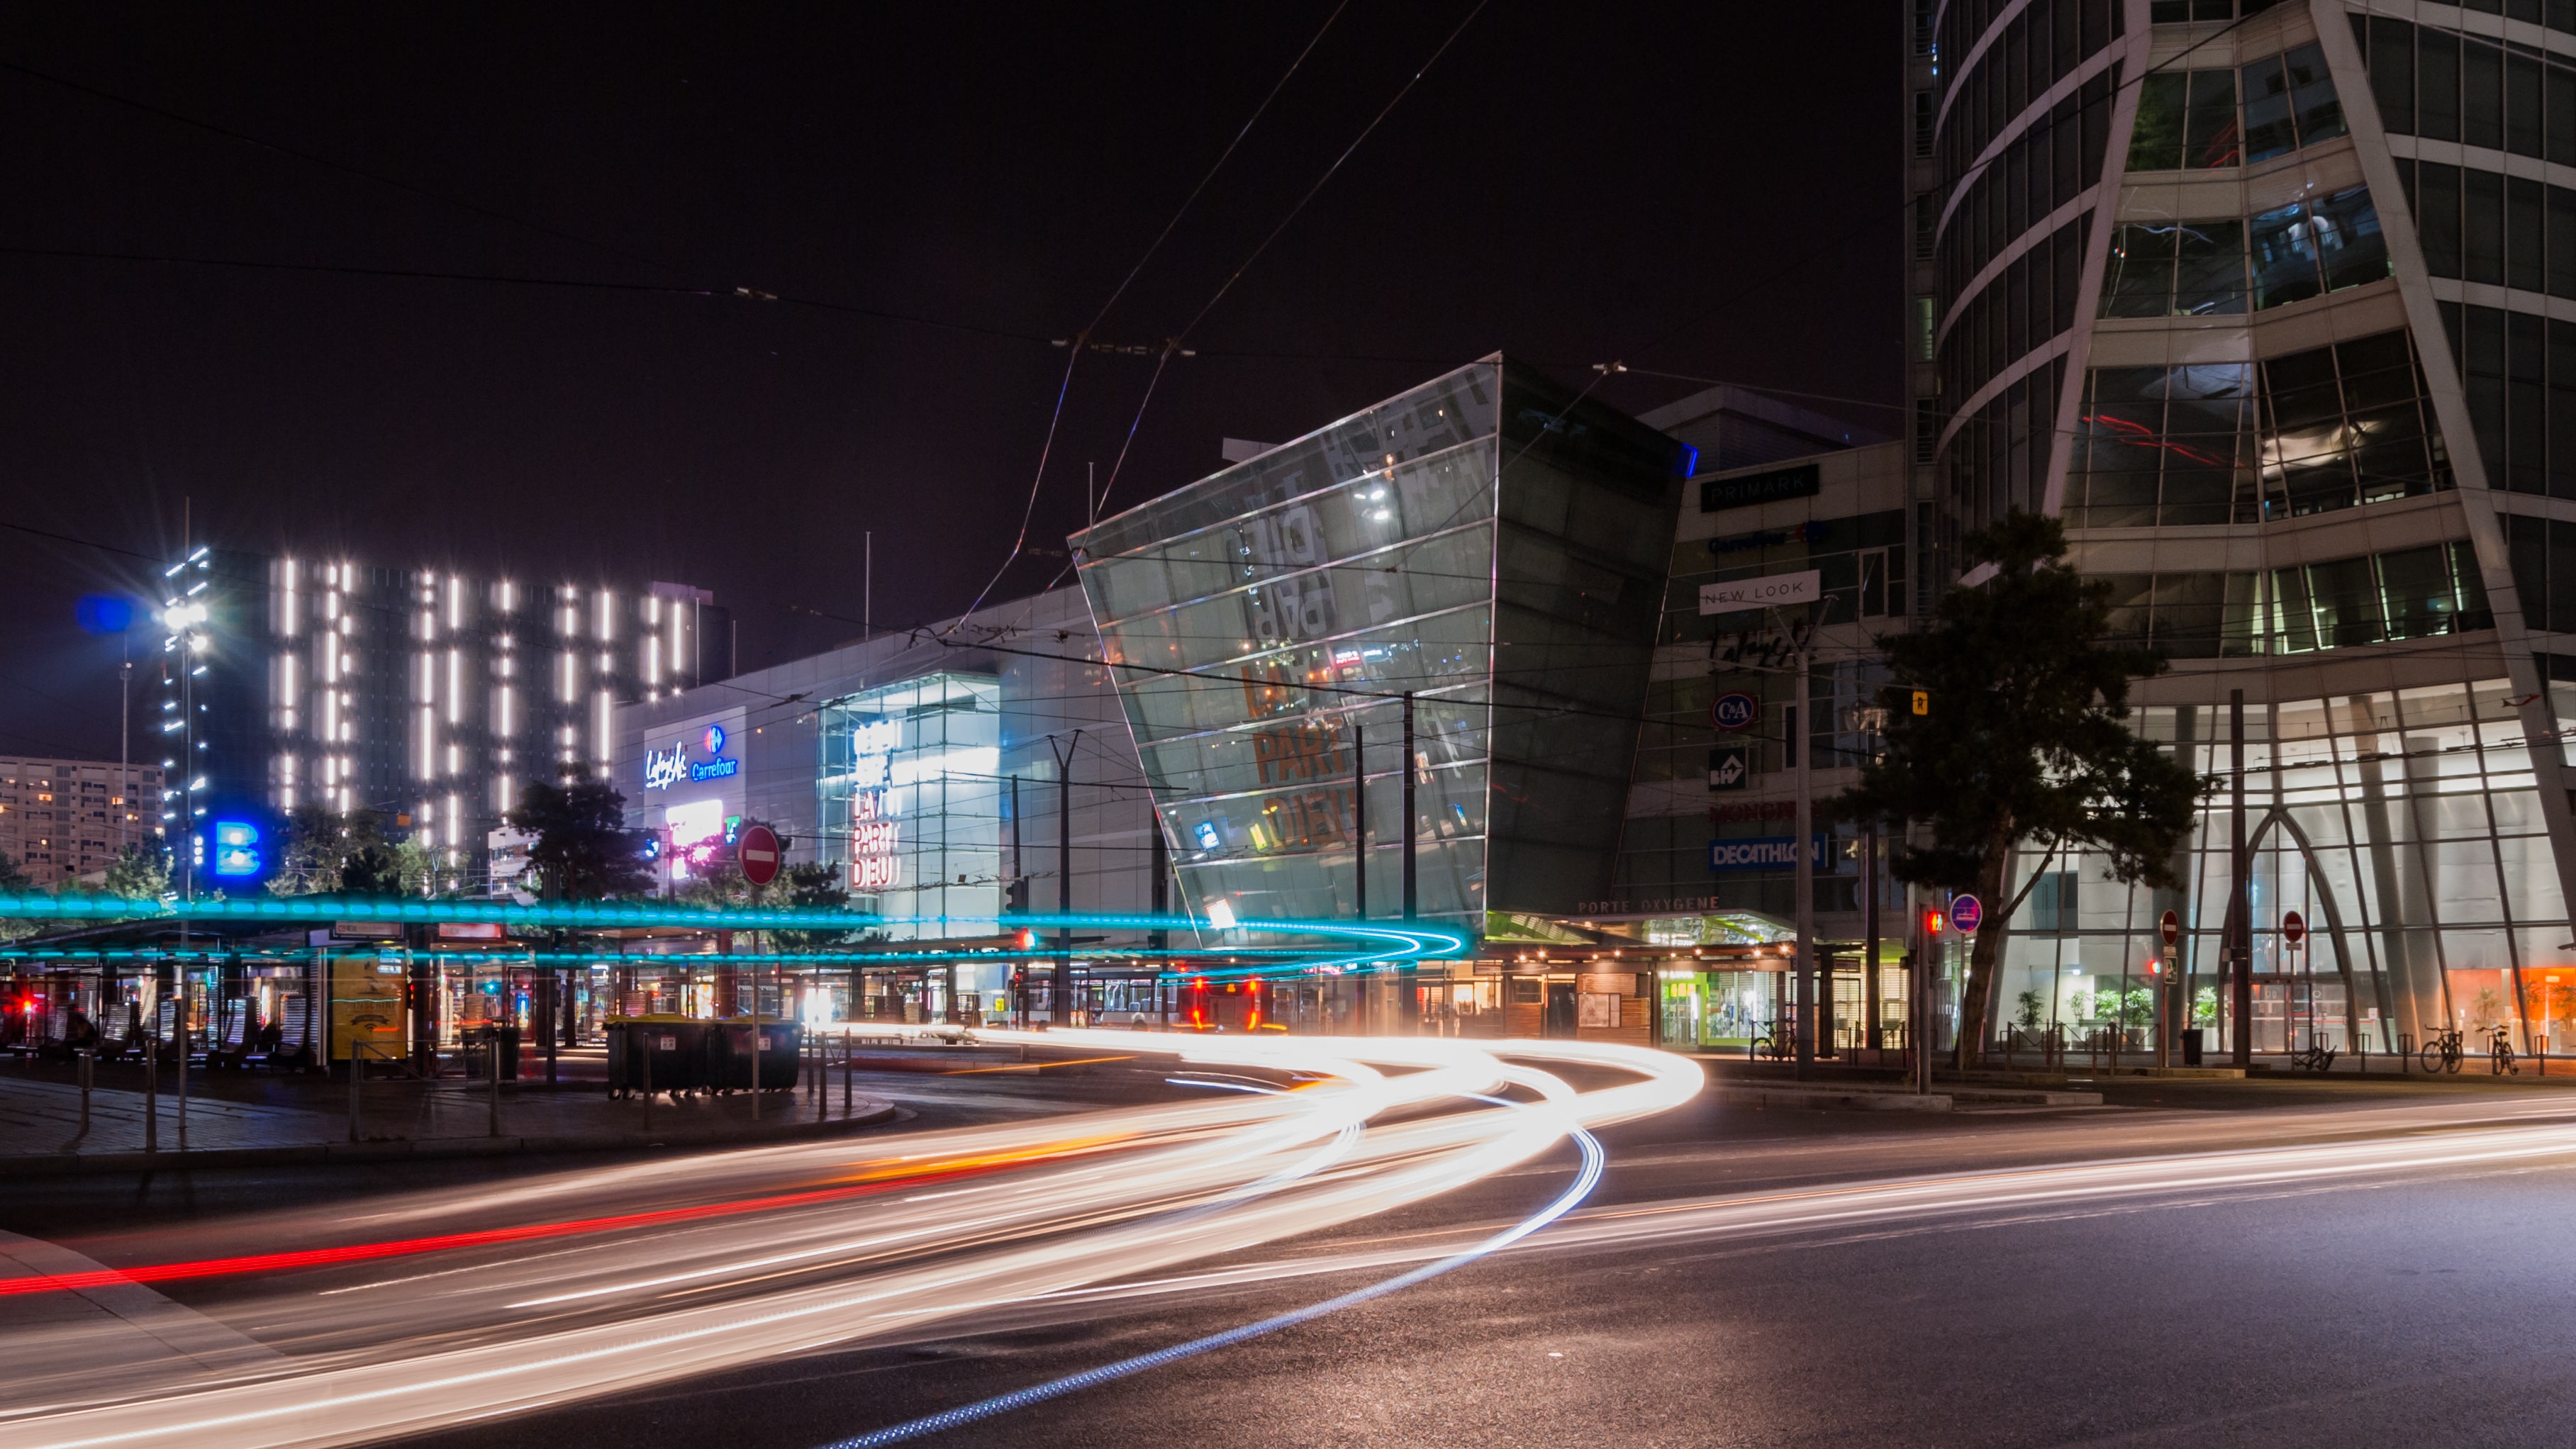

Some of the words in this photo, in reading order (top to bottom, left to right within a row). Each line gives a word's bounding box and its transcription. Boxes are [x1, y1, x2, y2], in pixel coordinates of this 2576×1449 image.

[1712, 474, 1804, 500] PRIMARK
[1705, 589, 1744, 605] NEW
[1755, 582, 1803, 598] LOOK
[1718, 703, 1749, 720] C&A
[691, 758, 737, 782] Carrefour
[852, 856, 895, 888] DIEU
[1578, 900, 1630, 914] PORTE
[1641, 896, 1719, 910] OXYGENE
